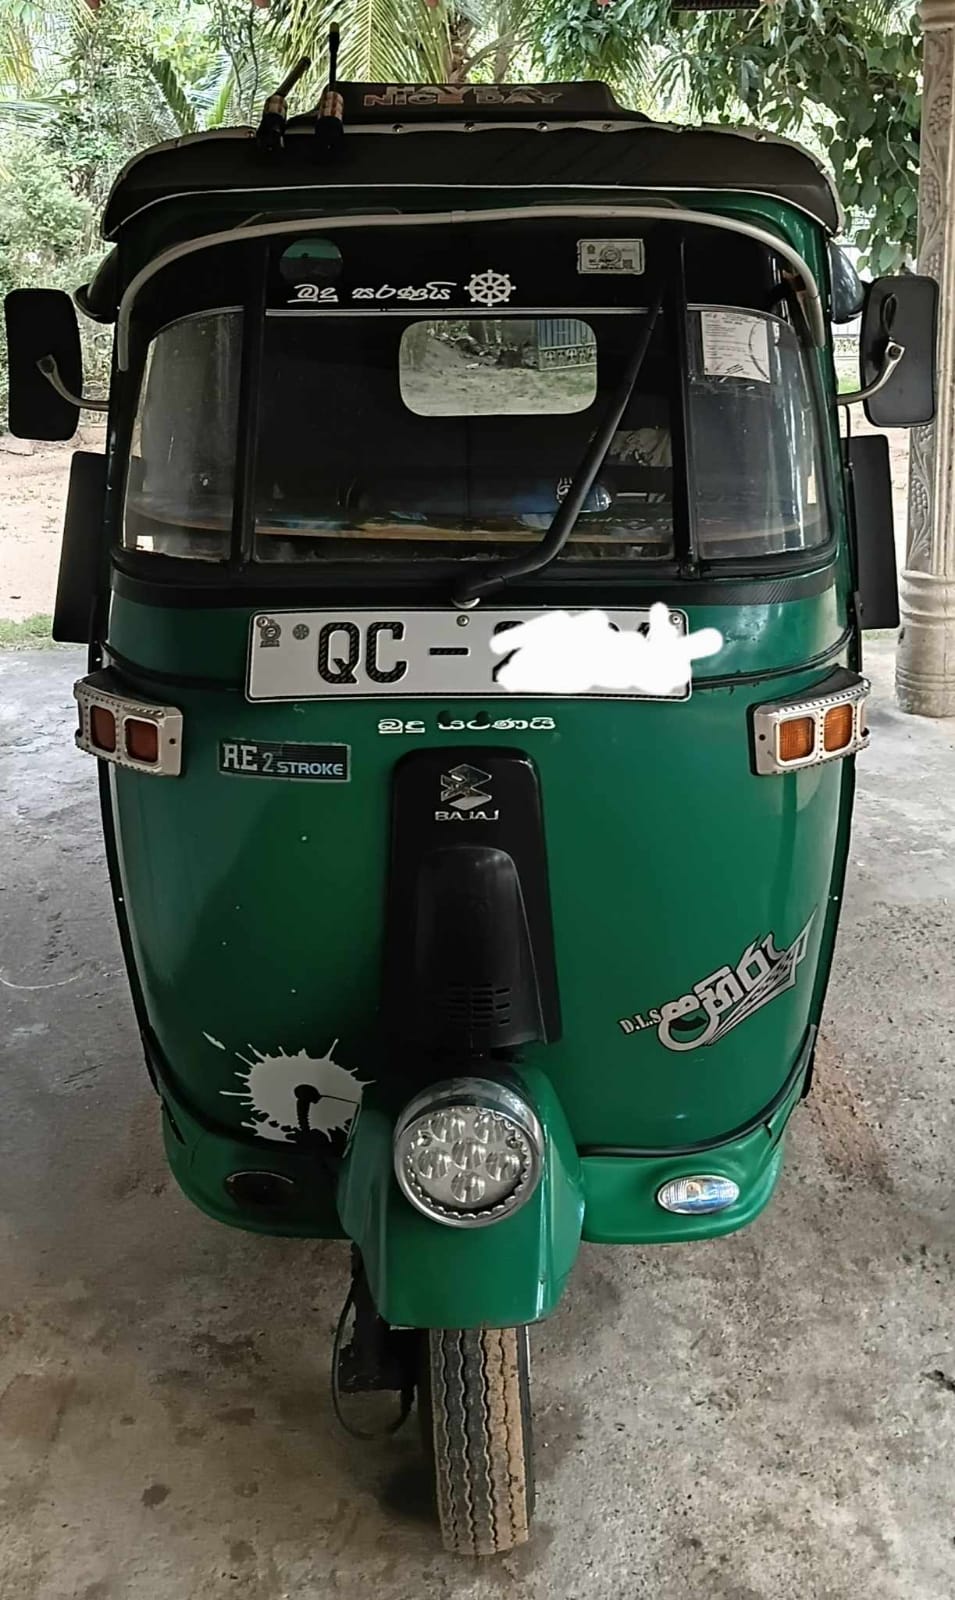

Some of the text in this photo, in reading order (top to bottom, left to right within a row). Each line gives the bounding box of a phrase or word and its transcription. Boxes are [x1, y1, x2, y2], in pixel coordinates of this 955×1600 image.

[364, 93, 563, 106] NICE DAY
[287, 283, 339, 303] බුදු
[317, 621, 408, 685] QC
[377, 718, 426, 734] බුදු
[222, 743, 344, 776] RE 2 STROKE
[434, 809, 499, 821] BAJAJ
